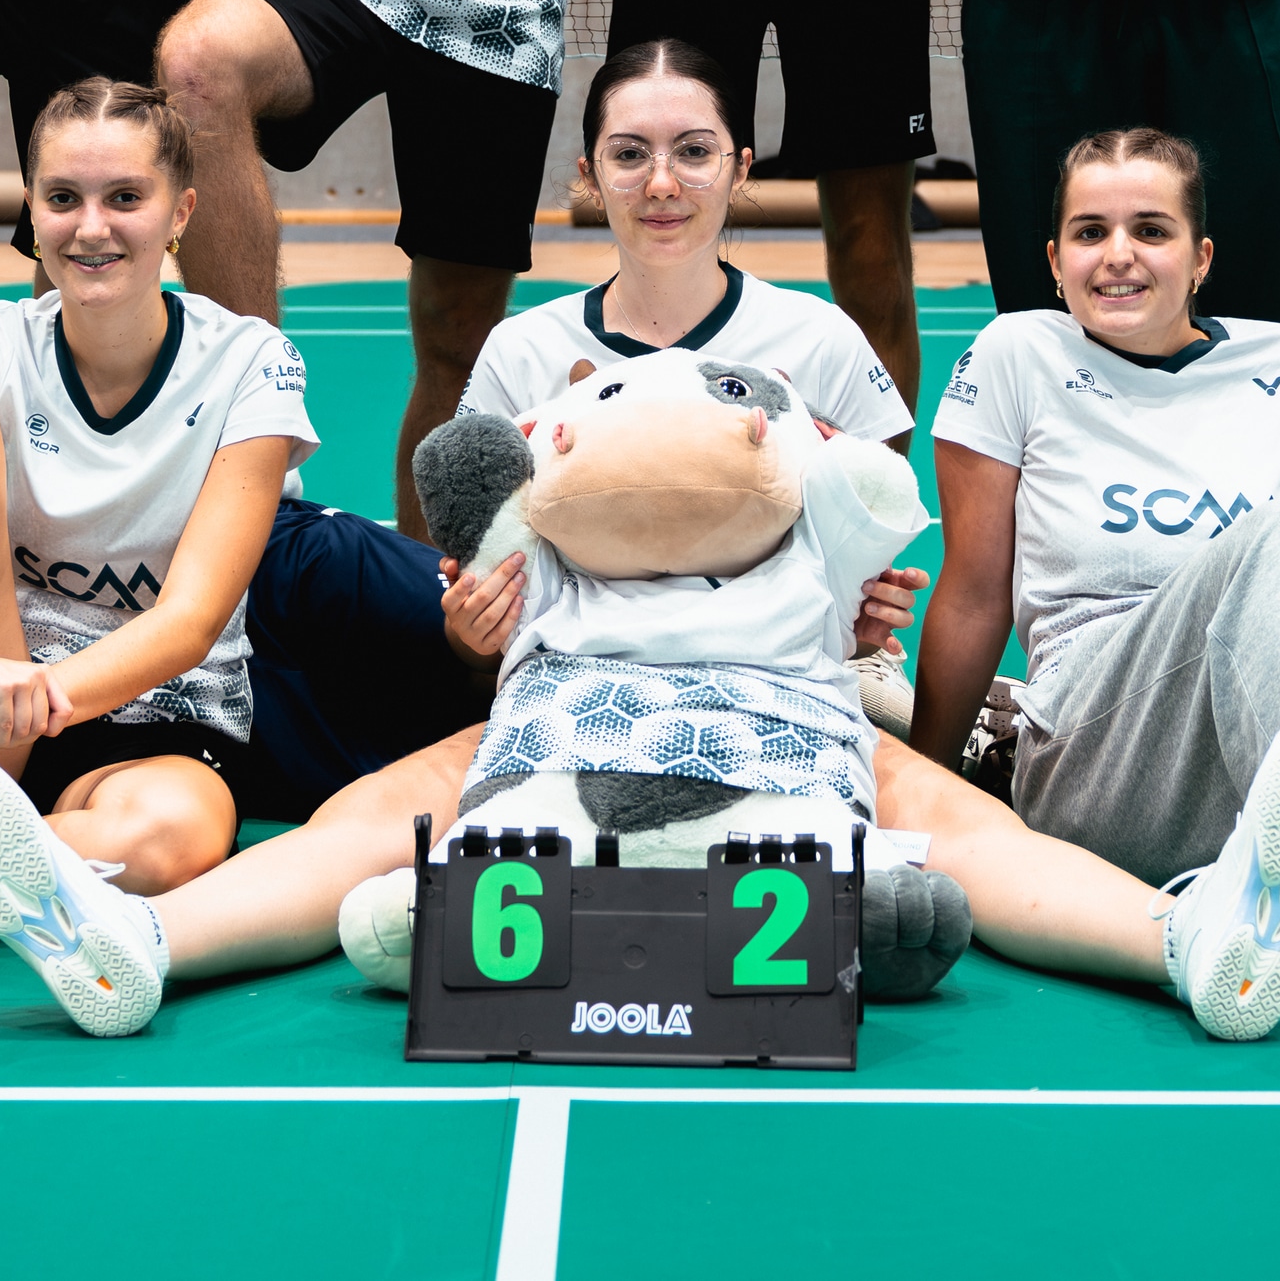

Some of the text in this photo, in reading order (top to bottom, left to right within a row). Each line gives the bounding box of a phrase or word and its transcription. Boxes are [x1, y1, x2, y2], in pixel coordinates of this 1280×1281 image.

[909, 113, 925, 134] FZ
[471, 861, 810, 987] 6 2
[570, 1001, 693, 1035] JOOLA
